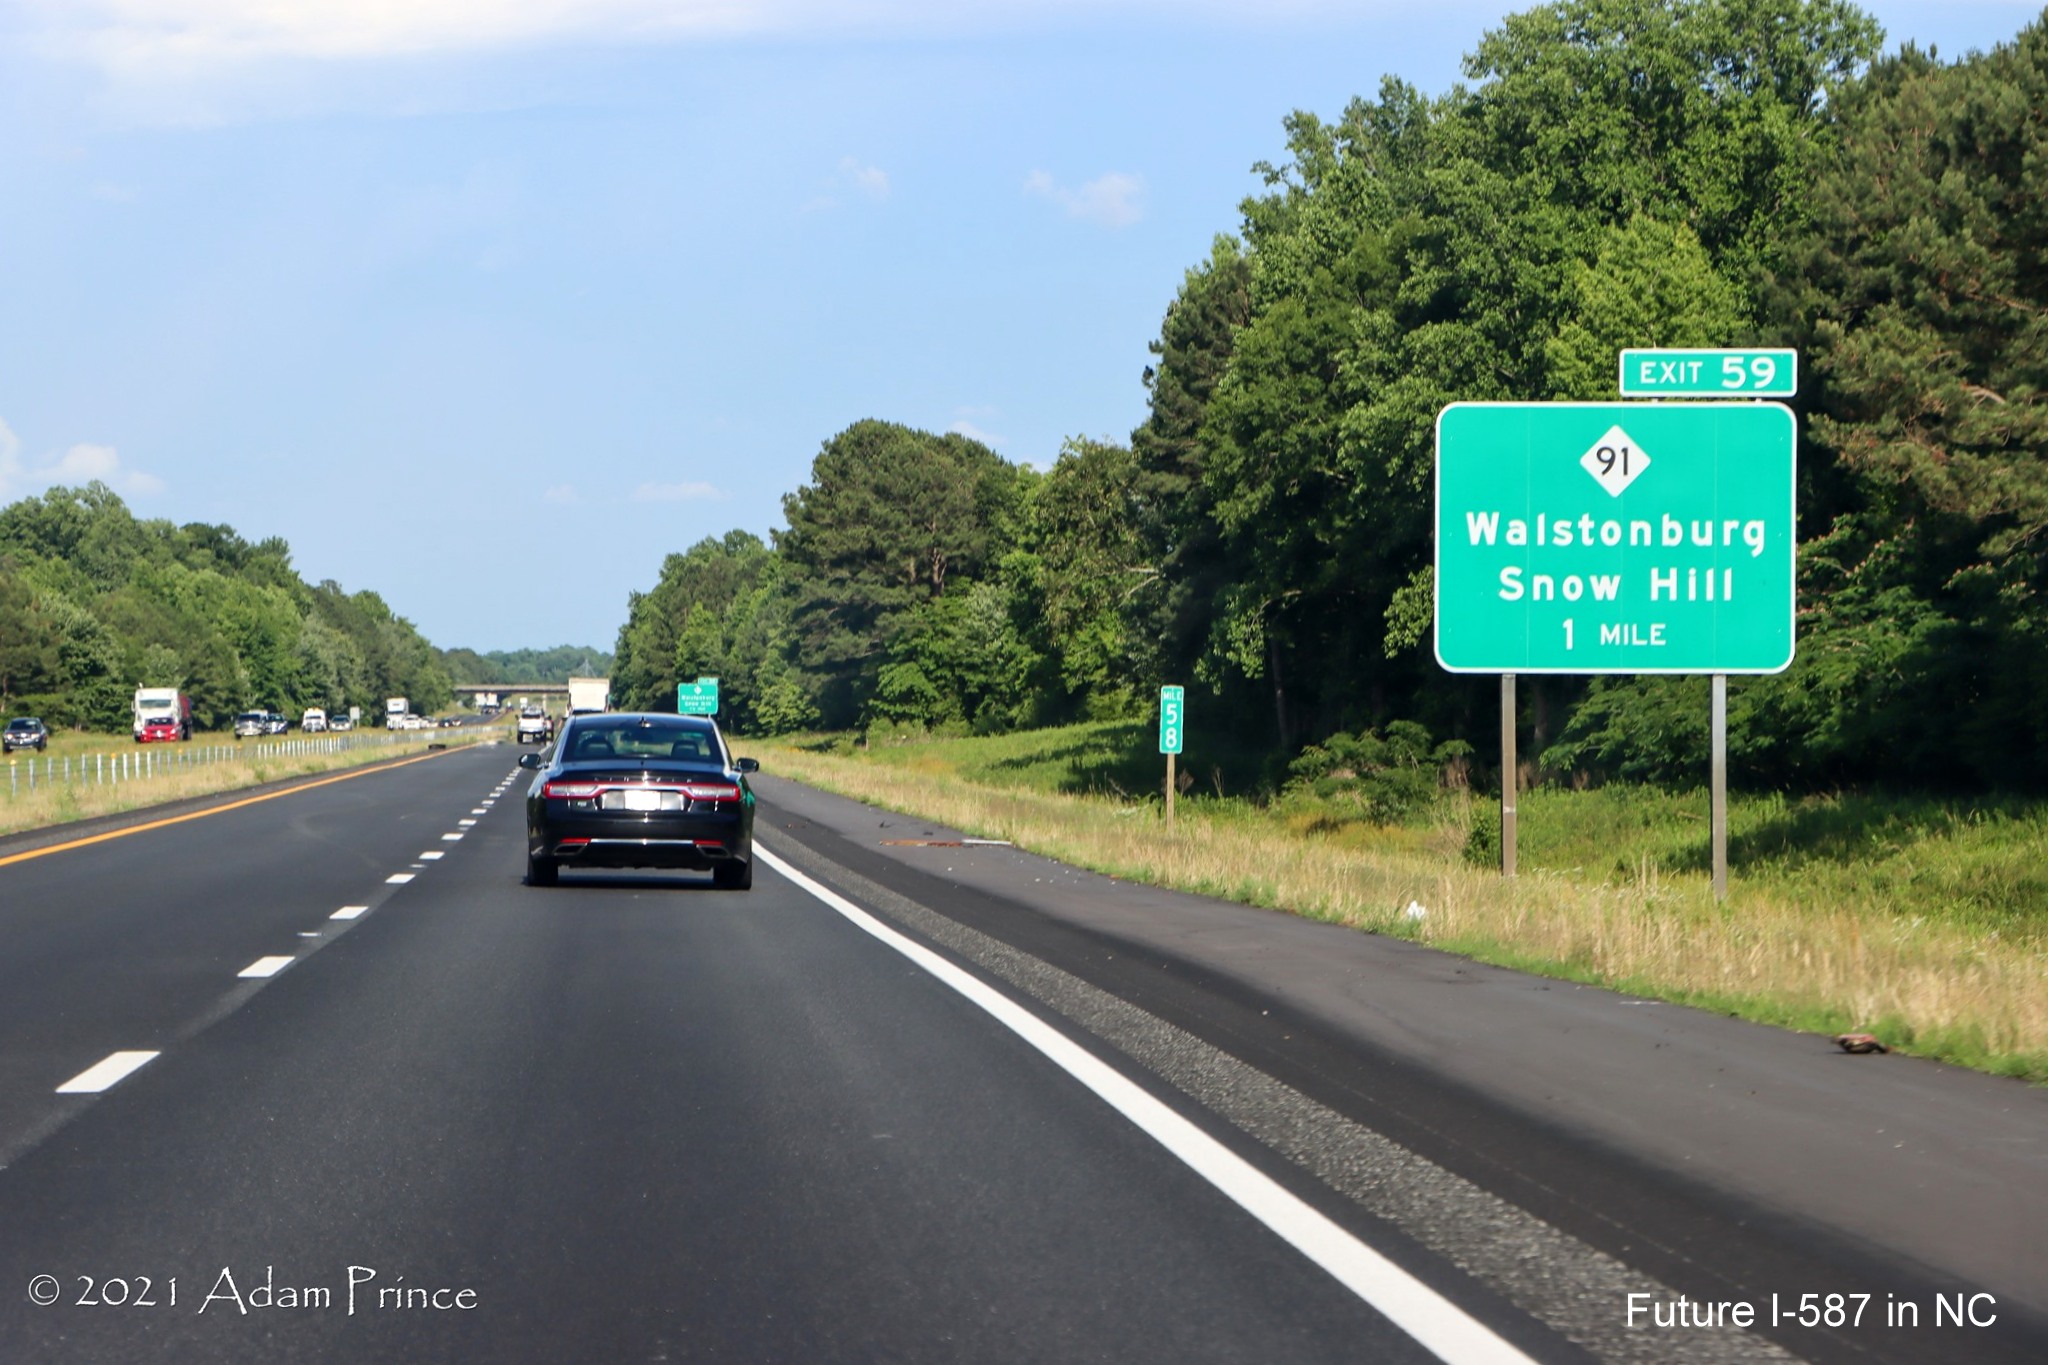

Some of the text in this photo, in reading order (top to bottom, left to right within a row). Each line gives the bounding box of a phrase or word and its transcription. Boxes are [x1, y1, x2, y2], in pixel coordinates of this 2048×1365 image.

[1640, 357, 1776, 389] EXIT 59
[1596, 446, 1629, 476] 91
[1466, 511, 1765, 558] Walstonburg
[1499, 566, 1733, 601] Snow Hill
[1562, 618, 1667, 650] 1 MILE
[1163, 691, 1182, 701] MILE
